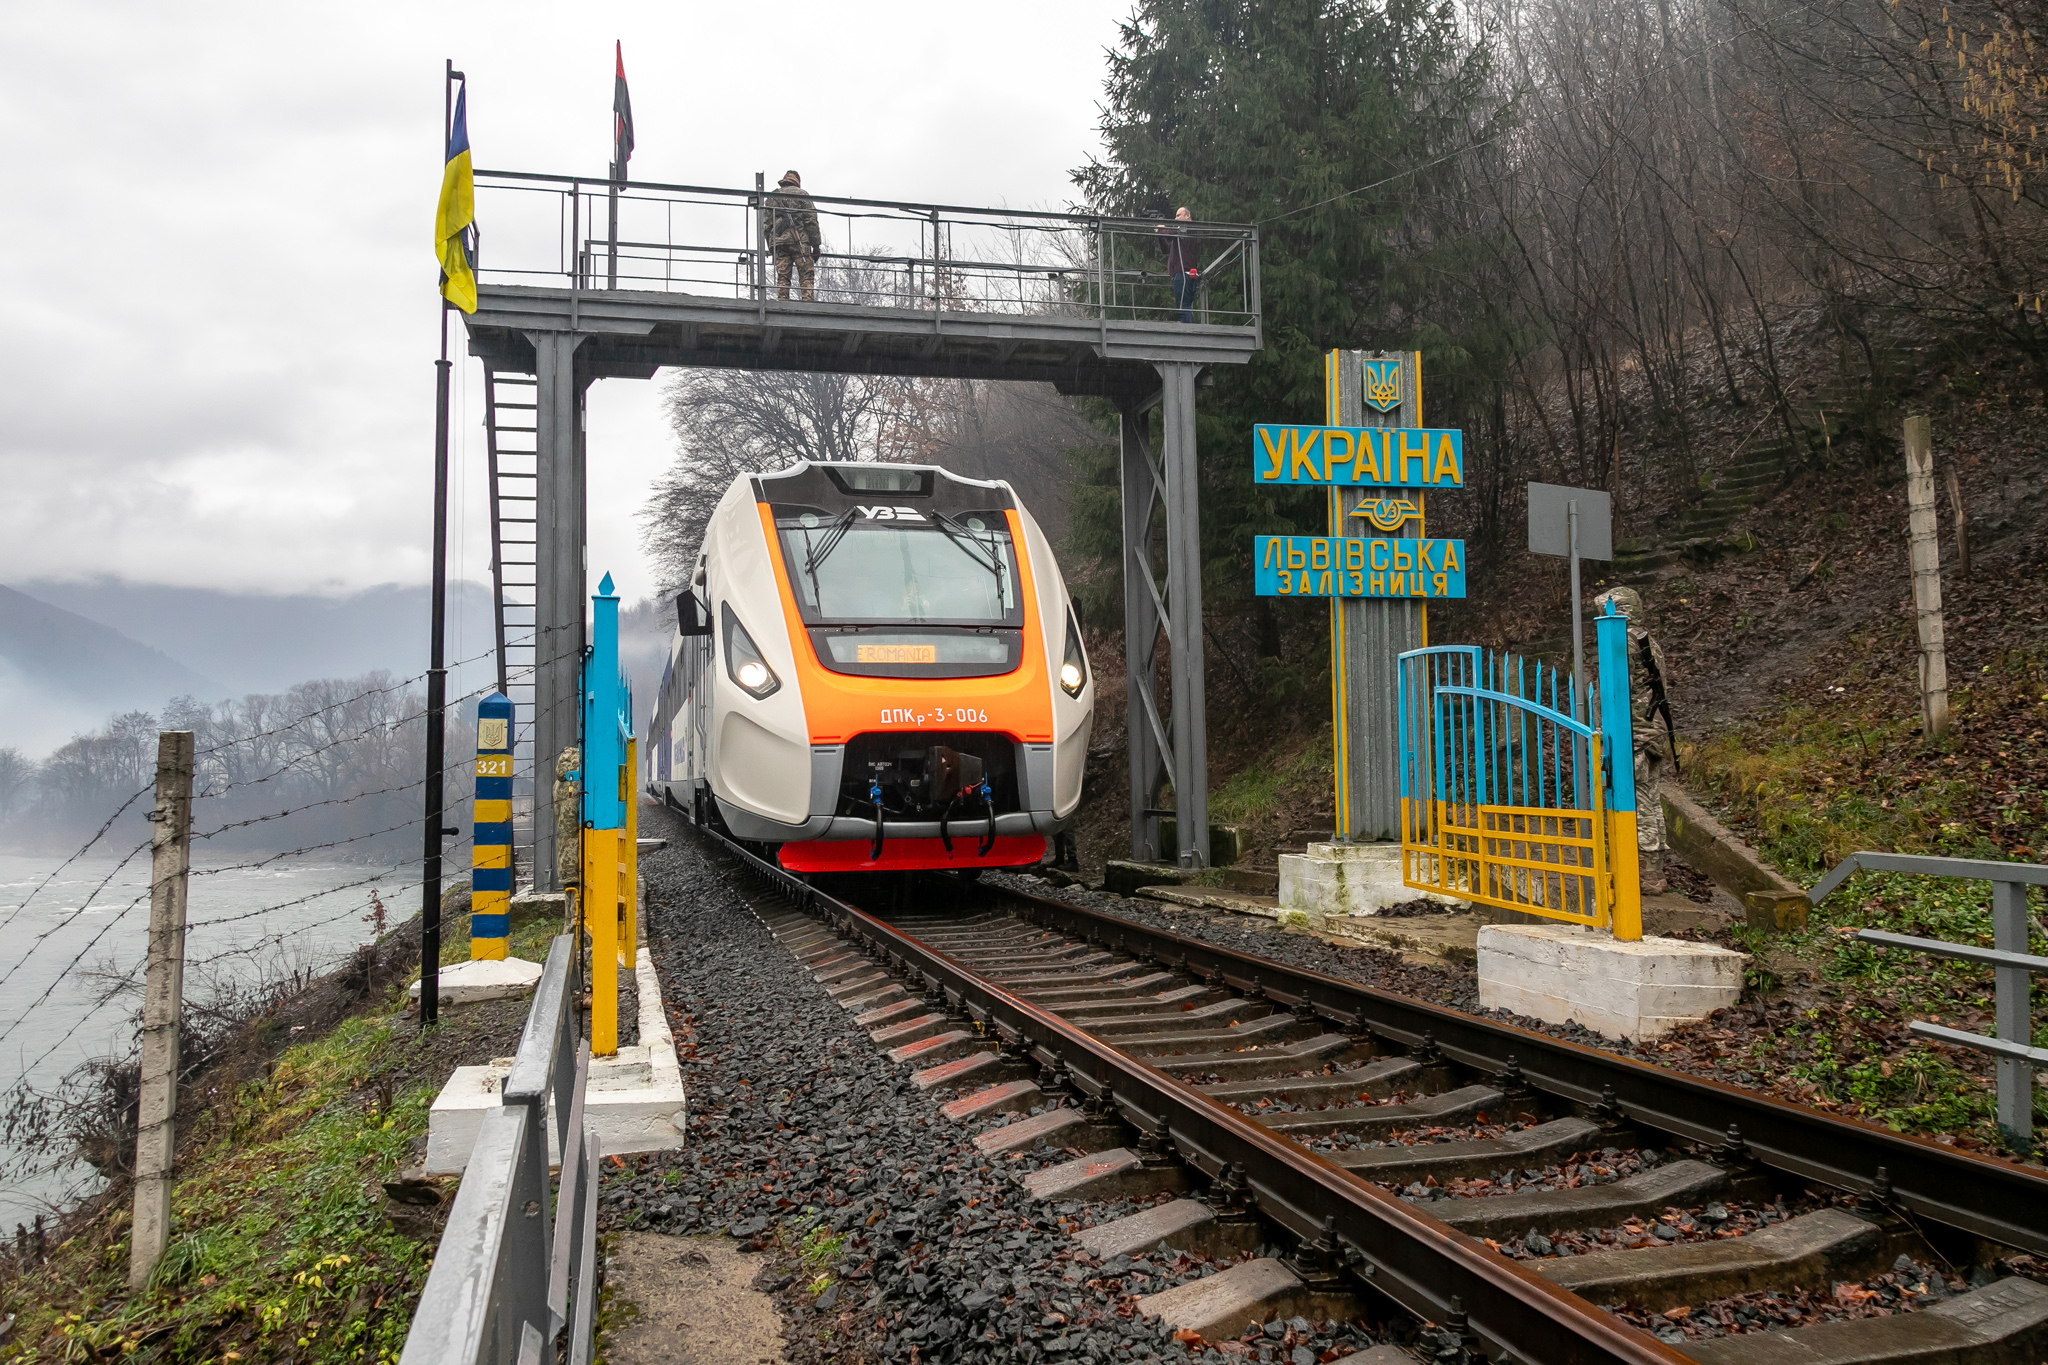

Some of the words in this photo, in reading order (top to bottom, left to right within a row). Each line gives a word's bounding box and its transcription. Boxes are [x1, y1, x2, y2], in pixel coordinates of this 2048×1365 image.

[1258, 428, 1461, 484] УКРАЇНА
[1264, 538, 1459, 571] ЛЬВІВСЬКА
[866, 647, 931, 661] ROMANIA
[477, 760, 506, 774] 321
